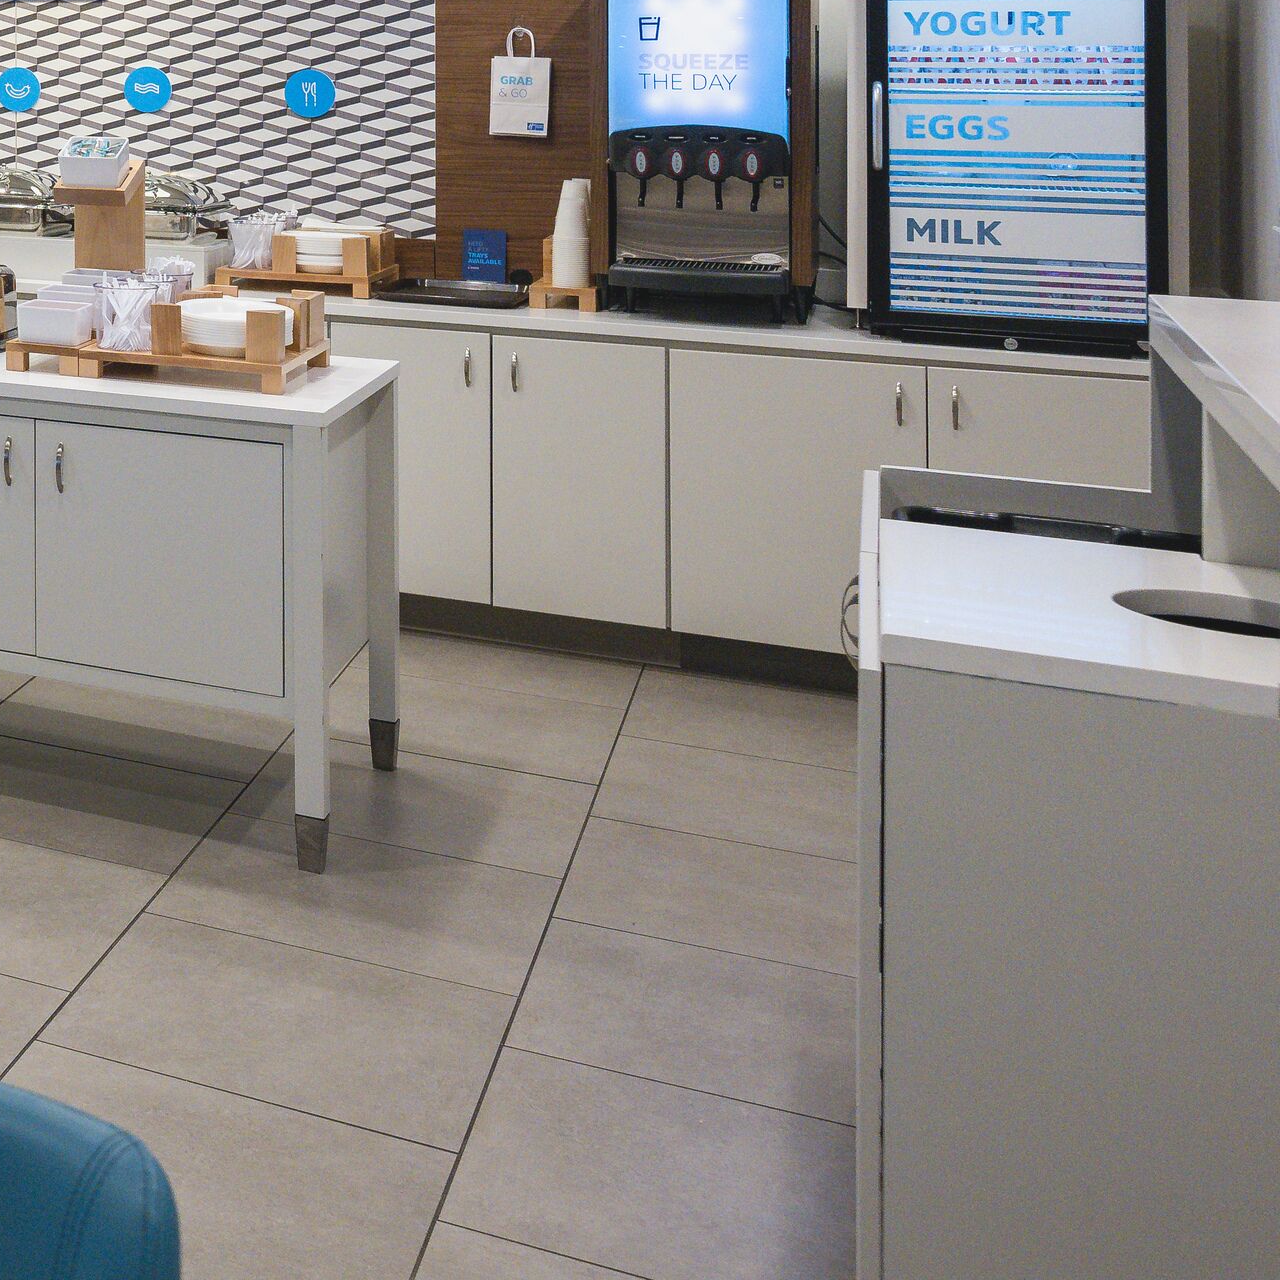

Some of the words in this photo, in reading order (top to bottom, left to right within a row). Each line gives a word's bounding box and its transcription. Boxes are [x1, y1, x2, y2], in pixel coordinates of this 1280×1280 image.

[903, 10, 1072, 37] YOGURT
[638, 53, 749, 71] SQUEEZE
[500, 75, 534, 86] GRAB
[638, 73, 682, 90] THE
[692, 73, 738, 90] DAY
[498, 87, 507, 98] &
[510, 88, 528, 98] GO
[905, 114, 1011, 141] EGGS
[906, 217, 1002, 246] MILK
